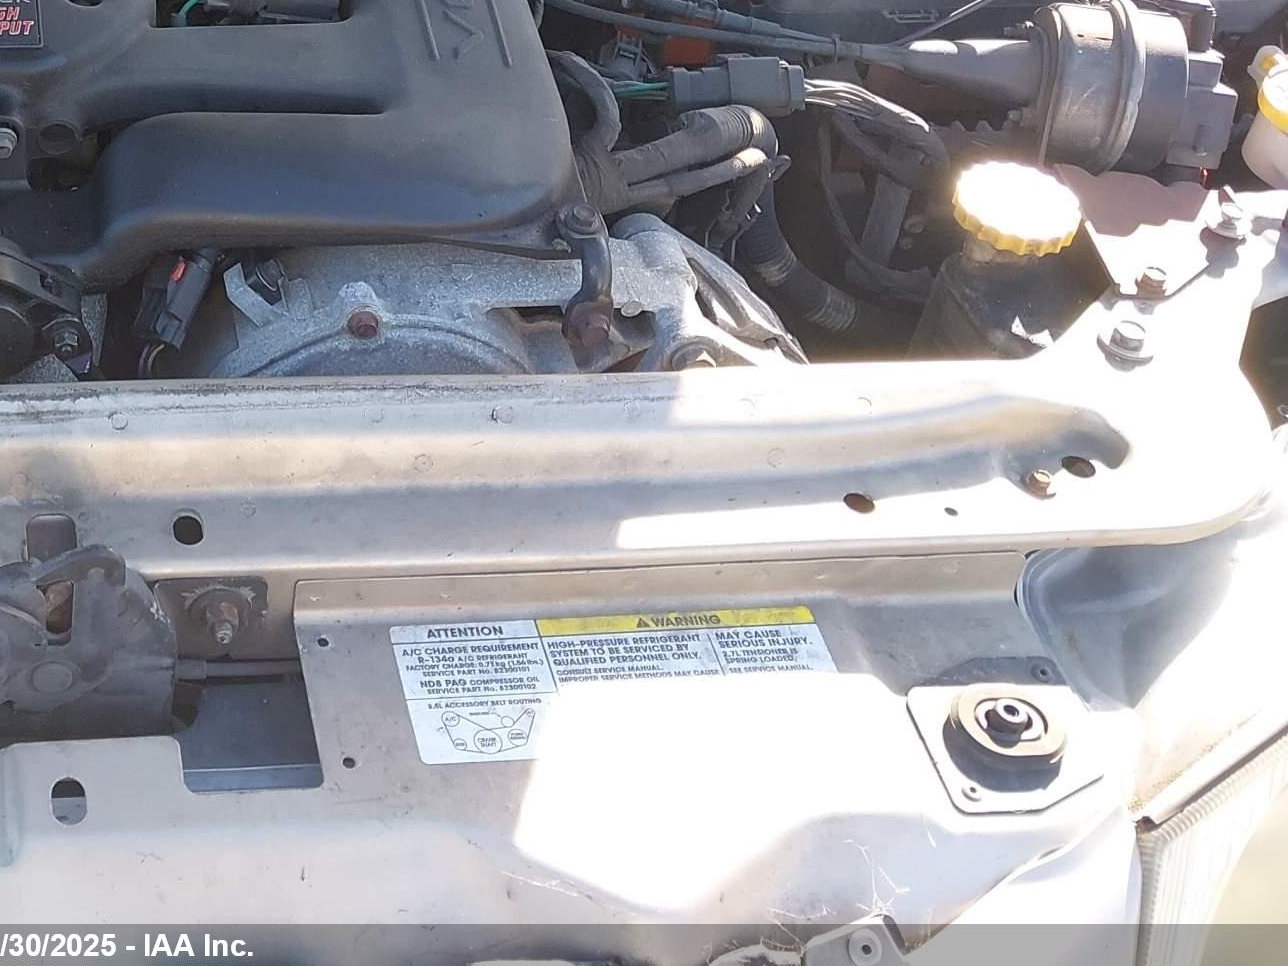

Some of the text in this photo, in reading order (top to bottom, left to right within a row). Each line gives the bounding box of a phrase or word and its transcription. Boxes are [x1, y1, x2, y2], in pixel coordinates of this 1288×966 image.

[651, 615, 722, 627] WARNING
[427, 626, 503, 639] ATTENTION
[715, 629, 782, 640] MAY CAUSE
[547, 634, 700, 649] HIGH-PRESSURE REFRIGERANT
[719, 636, 813, 649] SERIOUS INJURY.
[402, 642, 539, 656] A/C CHARGE REQUIREMENT
[550, 643, 689, 658] SYSTEM TO BE SERVICED BY
[477, 652, 528, 661] REFRIGERANT
[553, 651, 701, 666] QUALIFIED PERSONNEL ONLY.
[725, 656, 757, 664] SPRING
[406, 664, 440, 672] FACTORY
[556, 668, 592, 676] CONSULT
[445, 678, 467, 687] PAG
[470, 677, 524, 685] COMPRESSOR
[427, 687, 459, 695] SERVICE
[445, 701, 489, 709] ACCESSORY
